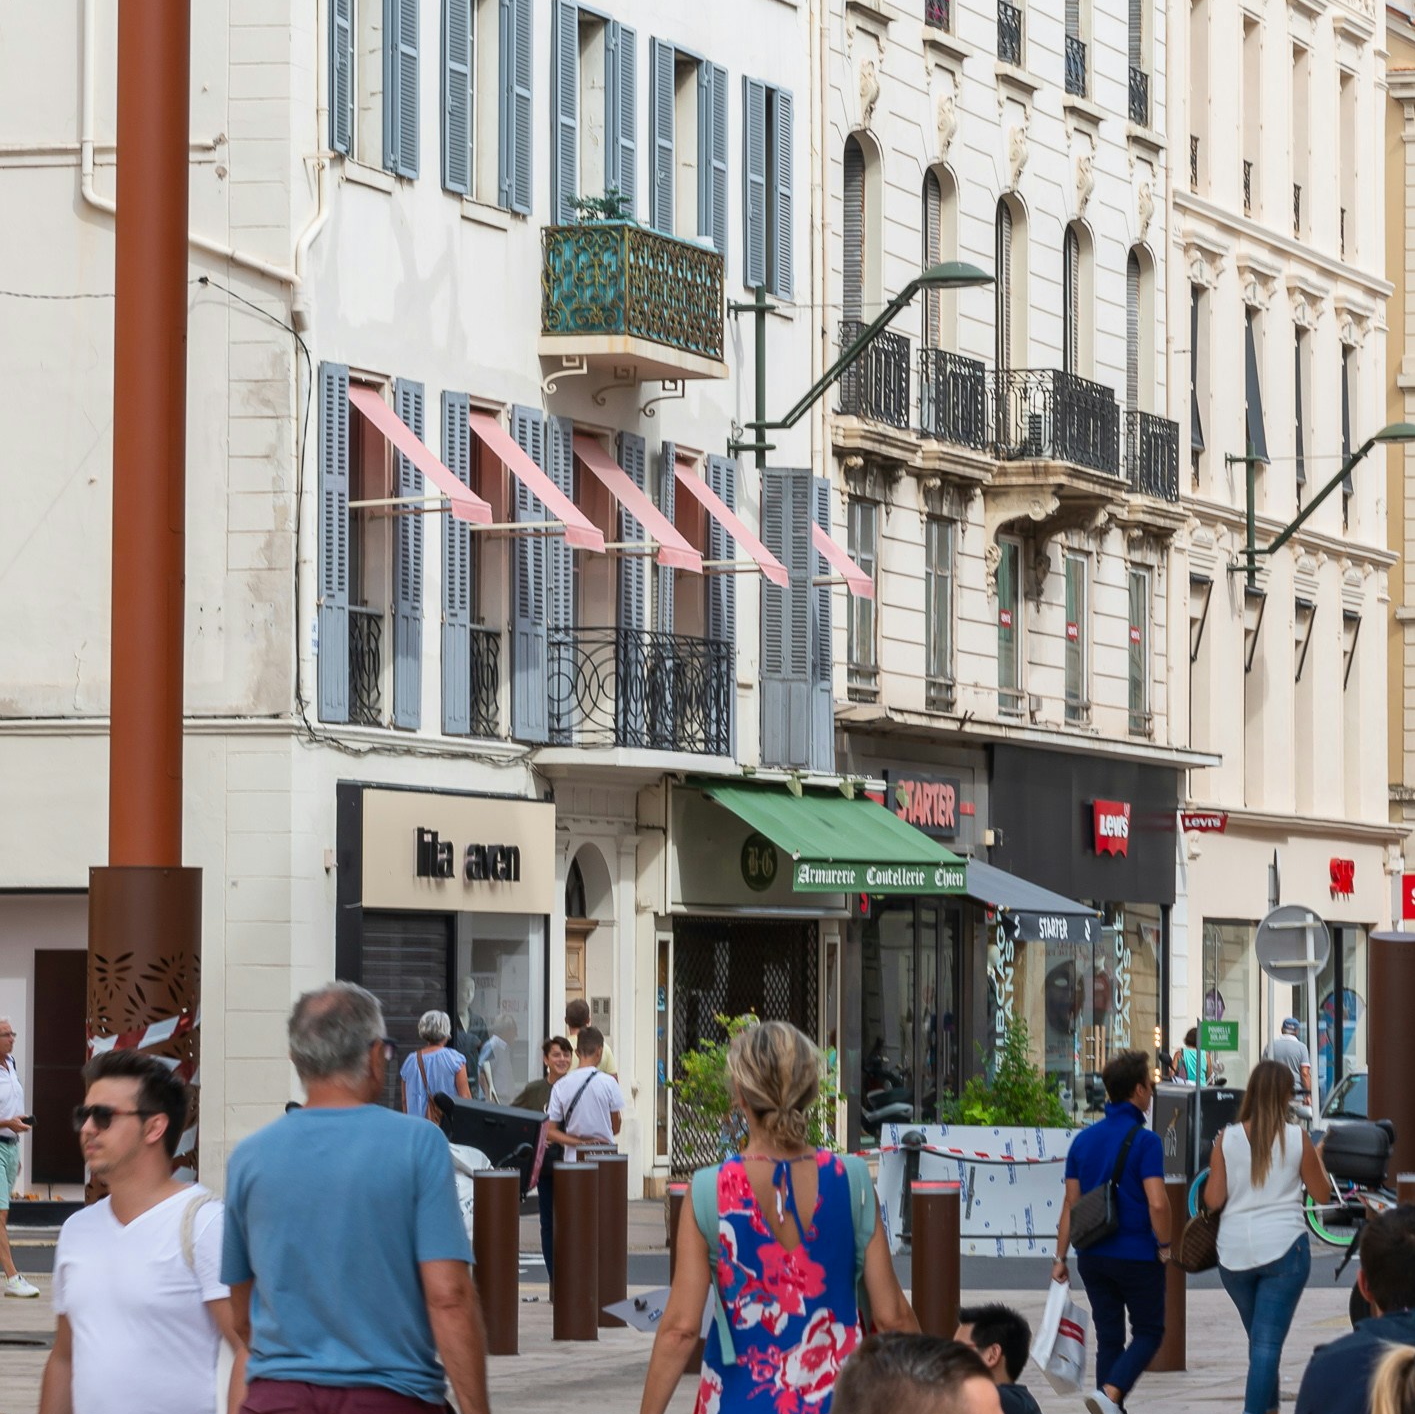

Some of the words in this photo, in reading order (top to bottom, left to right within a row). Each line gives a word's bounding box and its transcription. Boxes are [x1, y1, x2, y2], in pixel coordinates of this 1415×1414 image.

[895, 779, 956, 828] STARTER
[866, 865, 926, 887] Coutellerie
[1038, 916, 1069, 940] STARTER
[1122, 947, 1132, 1050] EANS
